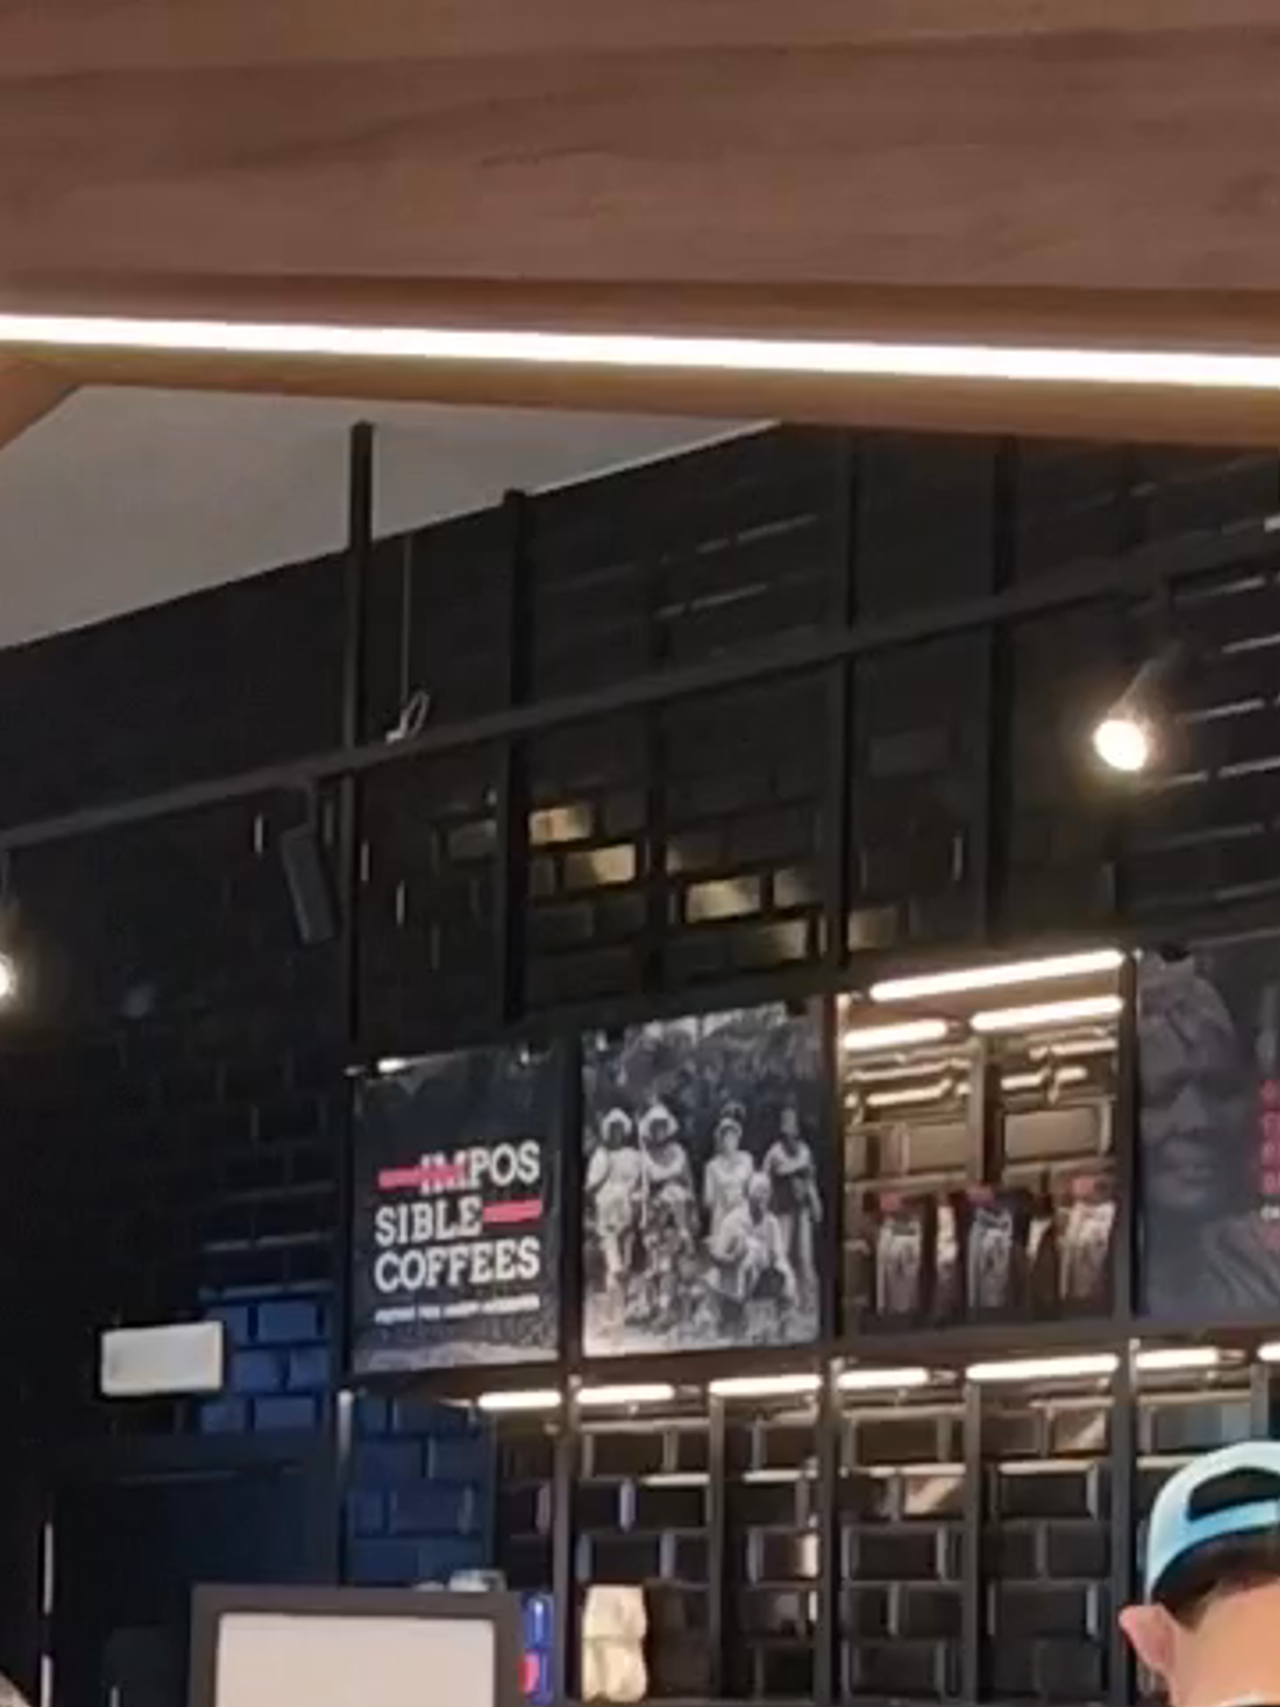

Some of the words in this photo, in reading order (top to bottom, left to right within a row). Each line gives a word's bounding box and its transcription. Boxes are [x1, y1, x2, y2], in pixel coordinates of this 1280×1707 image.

[420, 1140, 541, 1195] IMPOS
[375, 1195, 484, 1246] SIBLE
[374, 1236, 541, 1292] COFFEES
